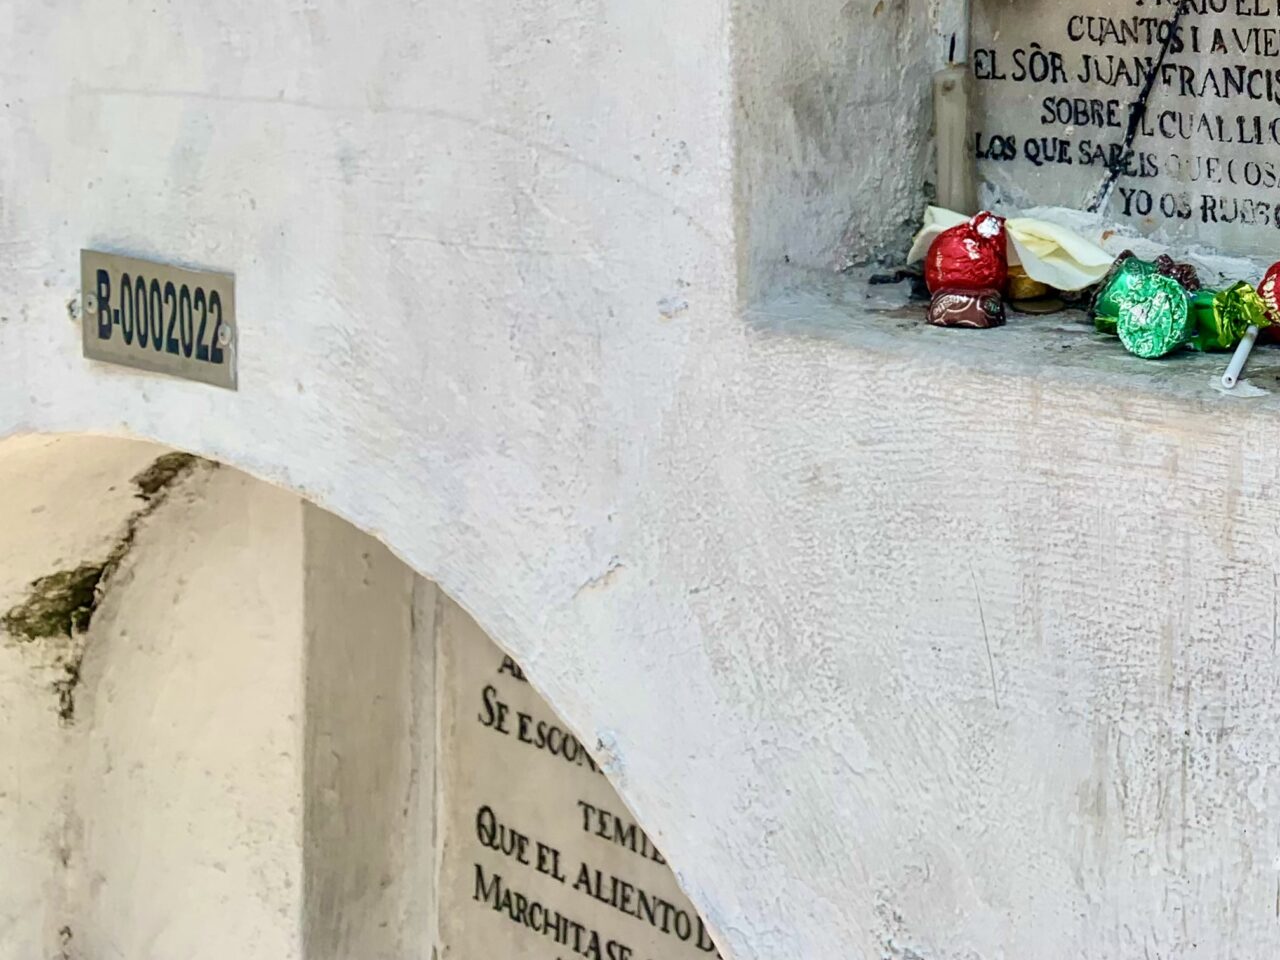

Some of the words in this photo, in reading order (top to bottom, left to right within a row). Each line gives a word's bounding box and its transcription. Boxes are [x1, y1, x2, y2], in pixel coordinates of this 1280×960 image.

[96, 268, 224, 365] B-0002022
[478, 685, 510, 735] SE
[517, 711, 605, 776] ESCON
[476, 805, 530, 866] QUE
[535, 840, 566, 883] EL
[572, 861, 692, 942] ALIENTO
